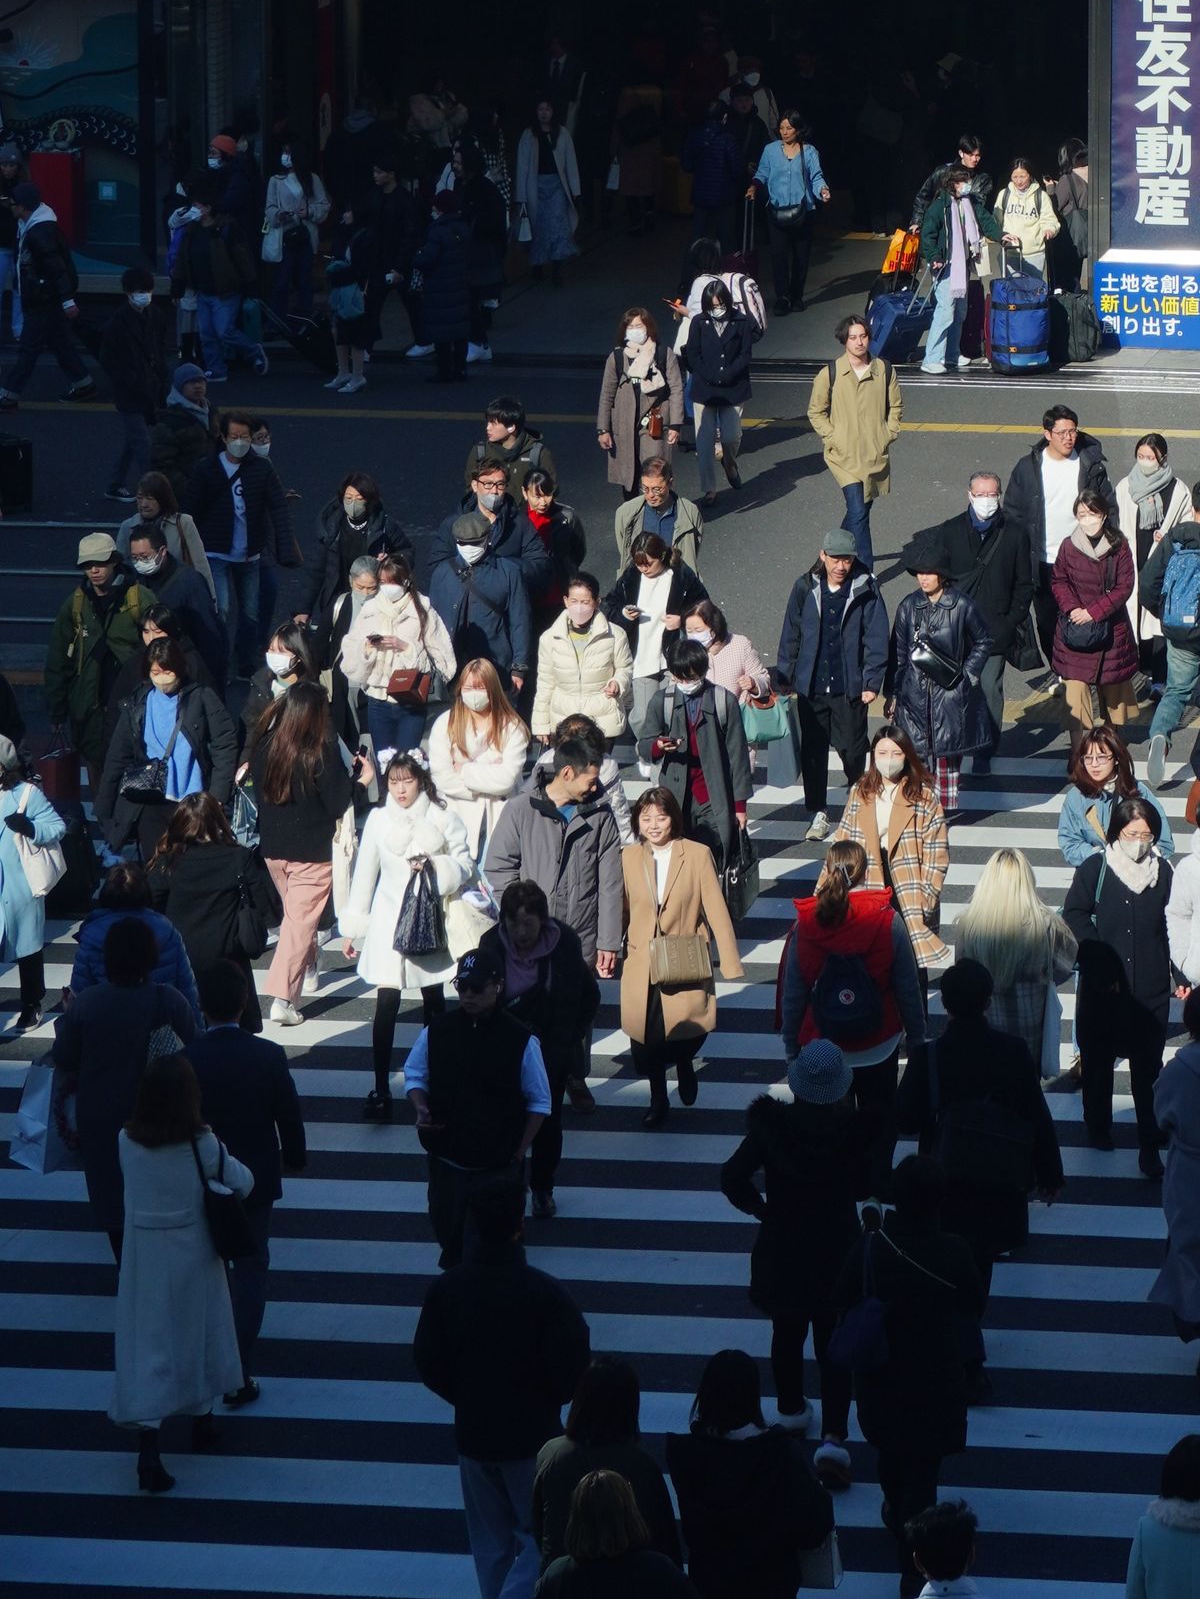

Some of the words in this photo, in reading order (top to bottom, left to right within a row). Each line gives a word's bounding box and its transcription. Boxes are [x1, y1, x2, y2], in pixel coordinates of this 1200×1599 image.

[1007, 204, 1038, 219] UCLA
[1101, 315, 1184, 337] 創り出す。
